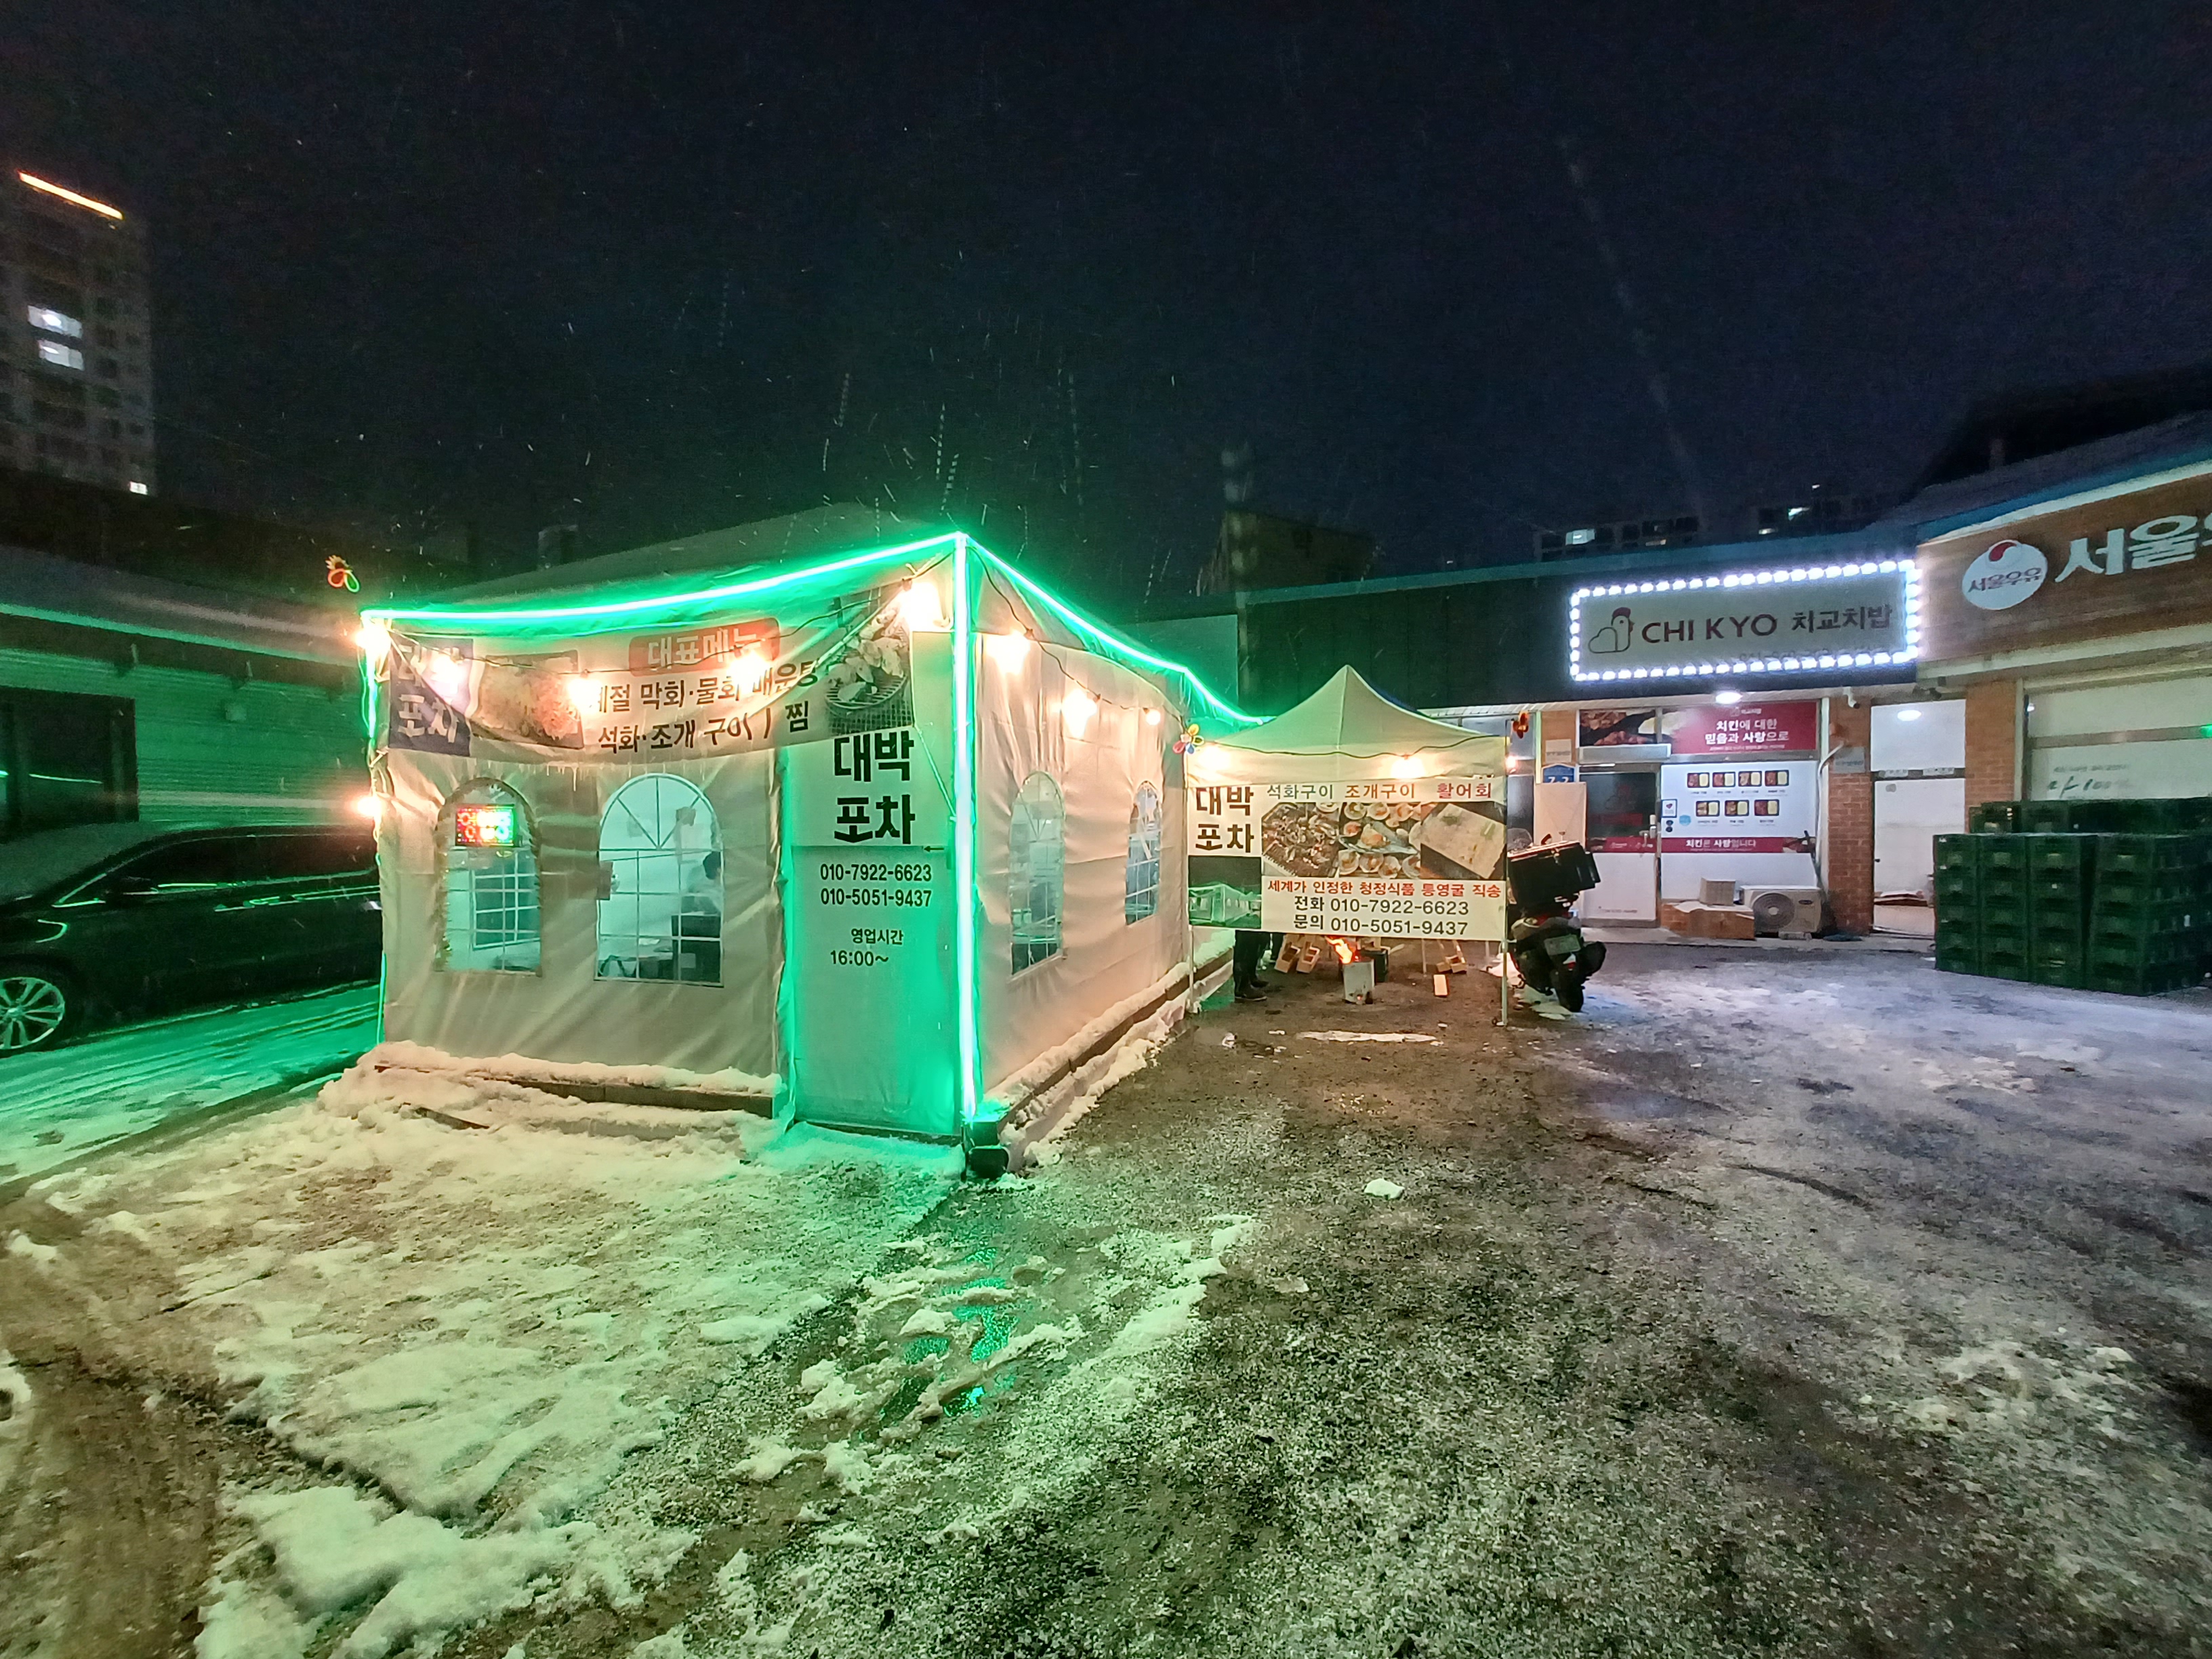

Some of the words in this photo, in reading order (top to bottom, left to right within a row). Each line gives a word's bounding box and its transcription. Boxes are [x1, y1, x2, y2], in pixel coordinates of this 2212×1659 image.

[2055, 512, 2212, 583] 서울
[1967, 567, 2043, 593] 서울우유
[1641, 619, 1694, 644] CHI
[1705, 613, 1778, 640] KYO
[398, 694, 459, 743] 포차
[785, 700, 809, 733] 찜
[1754, 718, 1778, 730] 대한
[1742, 731, 1790, 743] 사랑으로
[834, 730, 915, 783] 대박
[1195, 786, 1255, 816] 대박
[1267, 784, 1334, 800] 석화구이
[1345, 783, 1416, 799] 조개구이
[1436, 782, 1492, 799] 활어회
[834, 794, 916, 845] 포차
[1195, 823, 1255, 853] 포차
[820, 863, 933, 882] 010-7922-6623
[820, 888, 933, 907] 010-5051-9437
[1267, 880, 1307, 893] 세계가
[1313, 881, 1353, 895] 인정한
[1359, 882, 1415, 896] 청정식품
[1421, 883, 1465, 897] 통영굴
[1472, 884, 1502, 898] 직송
[1294, 896, 1325, 912] 전화
[1330, 898, 1469, 916] 010-7922-6623
[1293, 914, 1324, 930] 문의
[1330, 917, 1469, 935] 010-5051-9437
[851, 928, 904, 946] 영업시간
[830, 950, 889, 967] 16:00~
